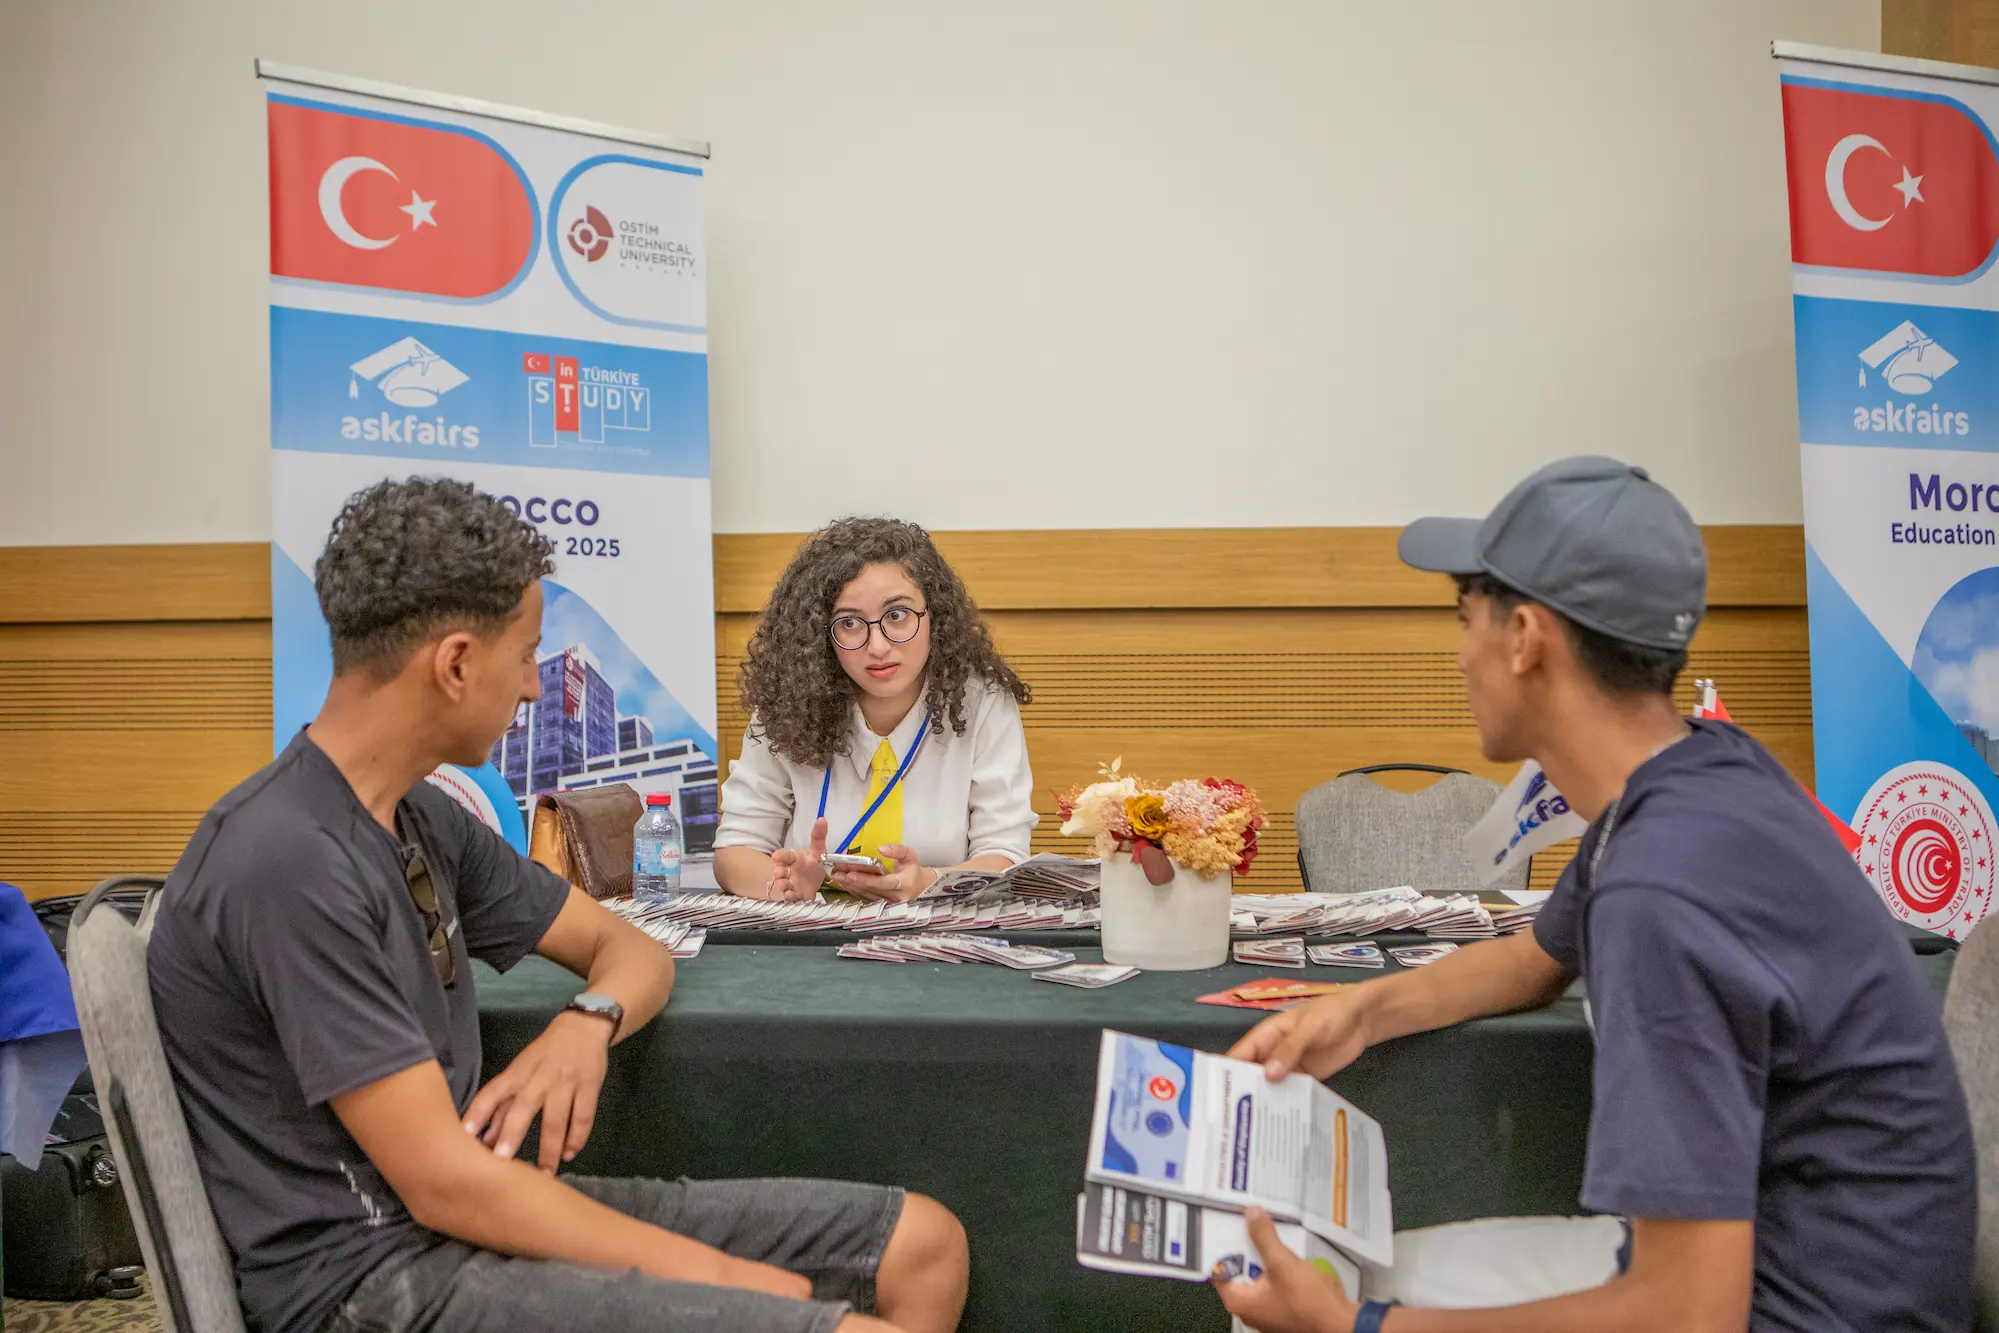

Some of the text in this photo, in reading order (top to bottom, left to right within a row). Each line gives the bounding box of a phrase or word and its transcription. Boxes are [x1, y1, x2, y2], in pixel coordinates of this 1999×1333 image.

[619, 234, 692, 255] TECHNICAL
[619, 248, 696, 269] UNIVERSITY
[560, 362, 640, 386] in TÜRKİYE
[535, 380, 644, 413] STUDY
[341, 411, 480, 448] askfairs
[1853, 400, 1970, 436] askfairs
[1909, 473, 1999, 513] Moroc
[498, 495, 599, 526] occo
[566, 537, 620, 557] 2025
[1891, 522, 1996, 546] Education
[1494, 795, 1570, 866] askfa
[1881, 805, 1970, 919] REPUBLIC OF TÜRKİYE MINISTRY OF TRADE
